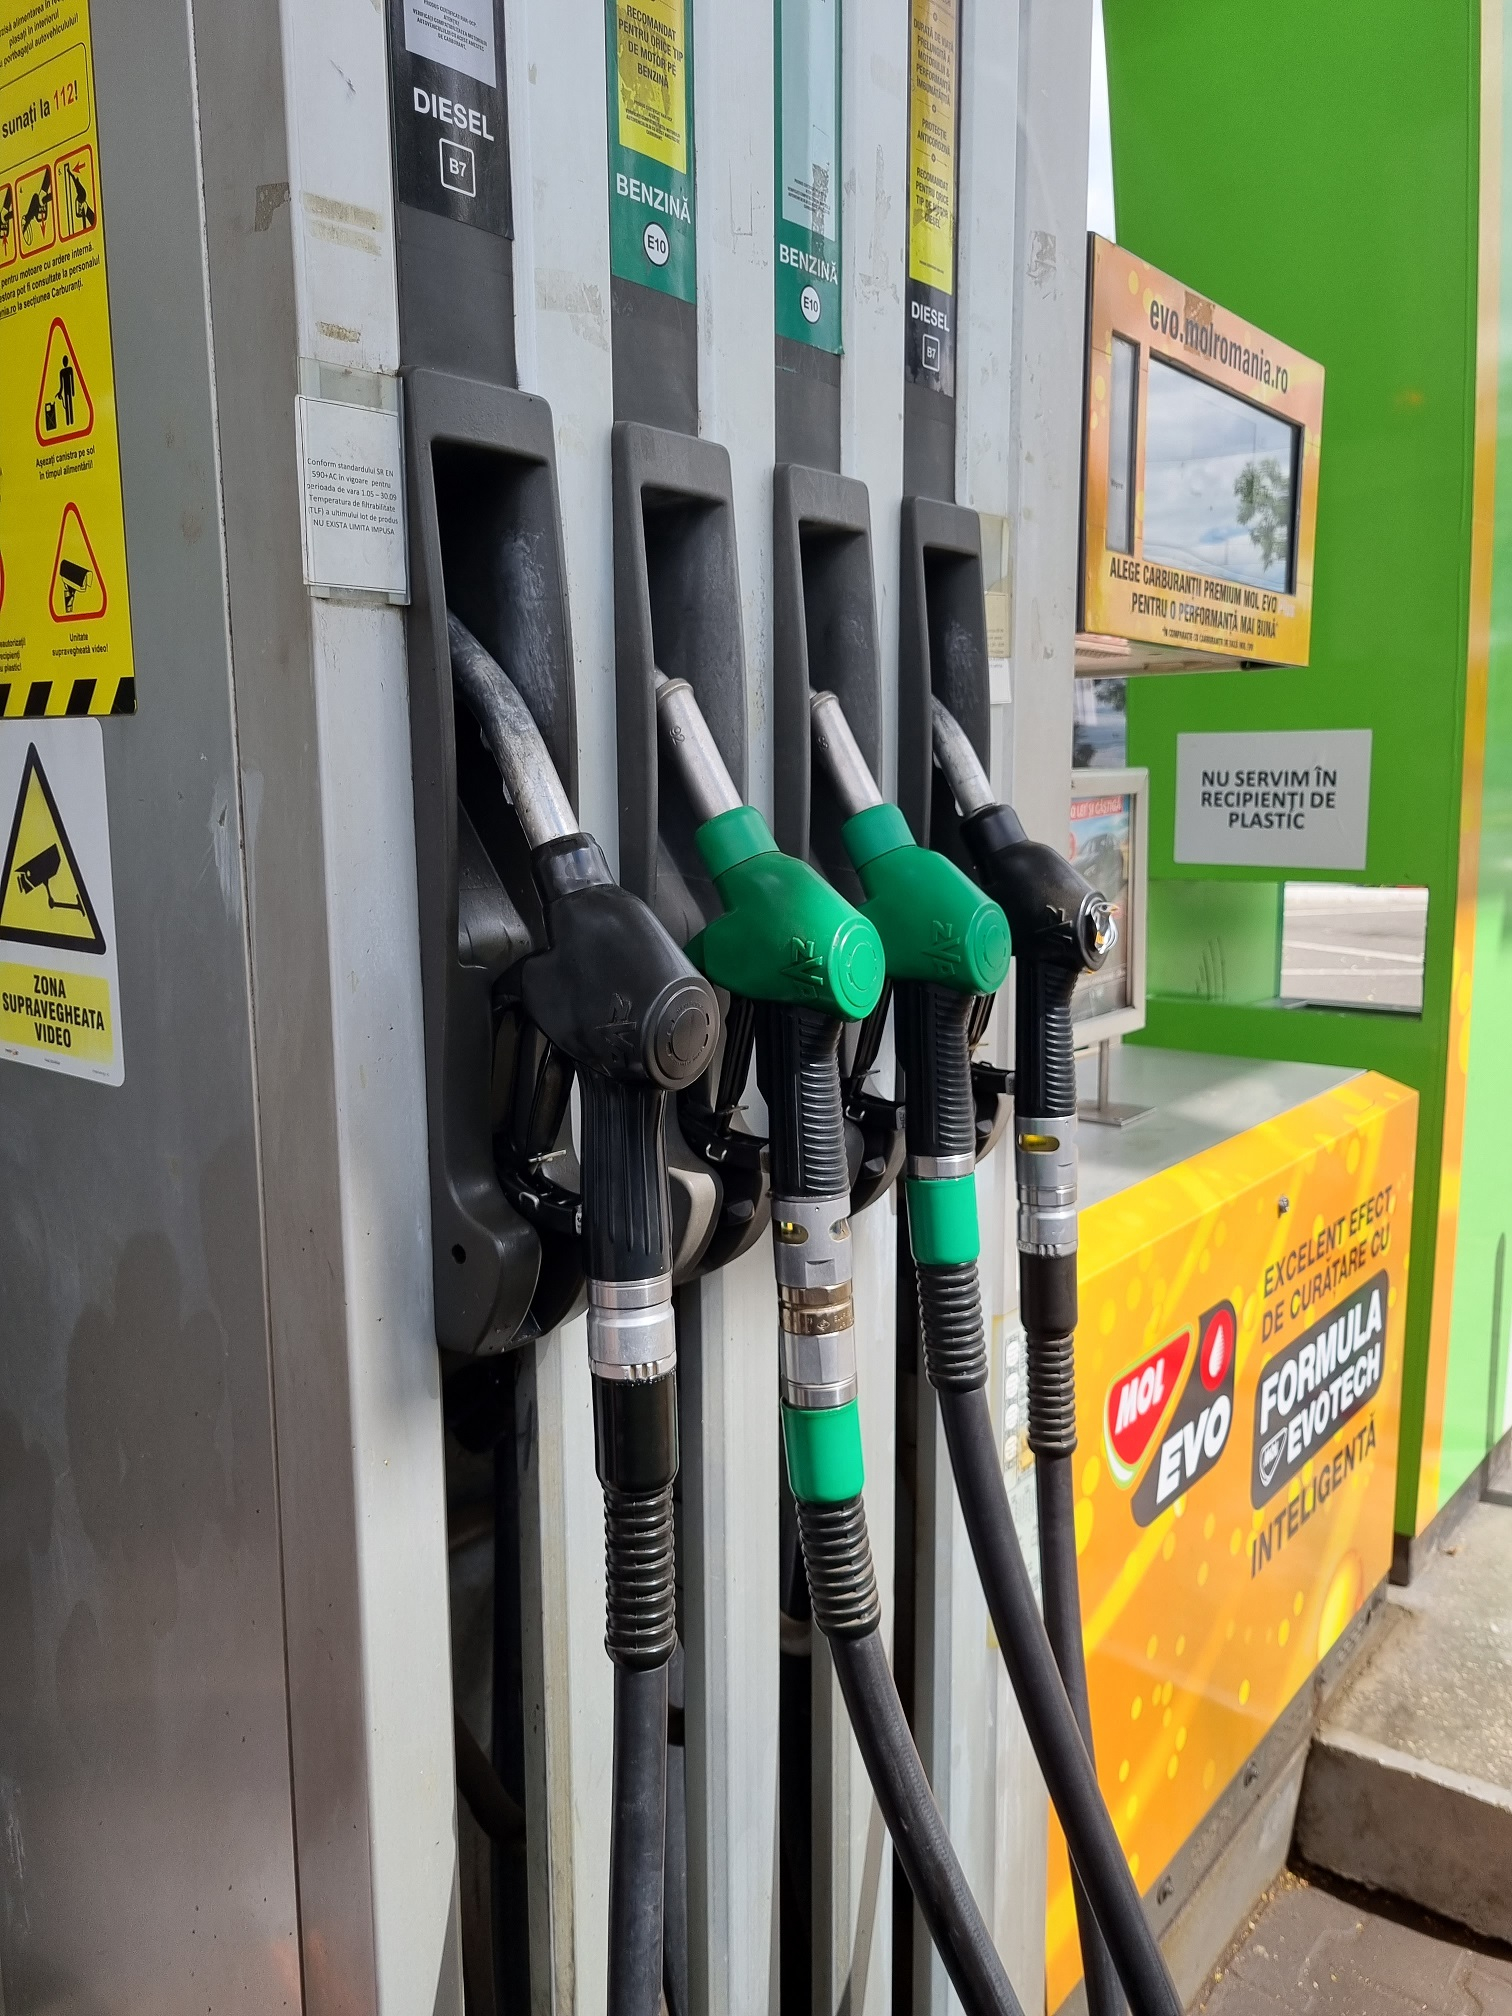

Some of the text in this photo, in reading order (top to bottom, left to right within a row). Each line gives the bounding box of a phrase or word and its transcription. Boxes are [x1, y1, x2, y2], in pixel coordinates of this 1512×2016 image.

[627, 5, 676, 41] RECOMANDAT
[619, 19, 683, 62] PENTRU ORICE TIP
[628, 41, 676, 76] DE MOTOR PE
[638, 63, 668, 88] BENZINĂ
[2, 80, 77, 138] sunați la 112!
[414, 87, 494, 142] DIESEL
[450, 158, 467, 177] B7
[917, 167, 948, 192] RECOMANDAT
[617, 173, 691, 224] BENZINĂ
[916, 181, 935, 198] PENTRU
[916, 195, 924, 205] TIP
[647, 235, 666, 254] E10
[1, 273, 18, 289] pentru
[20, 264, 42, 278] motoare
[44, 262, 51, 270] cu
[52, 253, 70, 266] ardere
[779, 244, 838, 285] BENZINĂ
[17, 285, 26, 298] pot
[27, 282, 31, 291] fi
[32, 272, 61, 290] consultate
[62, 269, 67, 278] la
[18, 302, 22, 311] la
[24, 292, 50, 308] secțiunea
[804, 296, 818, 312] E10
[911, 301, 950, 332] DIESEL
[927, 346, 936, 359] B7
[1150, 300, 1288, 394] evo.molromania.ro
[56, 451, 77, 463] canistra
[78, 449, 85, 458] pe
[87, 445, 95, 455] sol
[46, 467, 62, 479] timpul
[308, 457, 336, 468] Conform
[338, 462, 375, 474] standardului
[386, 469, 394, 478] EN
[307, 483, 336, 493] perioada
[338, 485, 345, 493] de
[347, 488, 360, 496] vara
[362, 488, 374, 498] 1.05
[346, 475, 368, 485] vigoare
[371, 479, 391, 488] pentru
[309, 494, 351, 506] Temperatura
[353, 499, 360, 507] de
[314, 519, 394, 535] NU EXISTA LIMITA IMPUSA
[332, 509, 358, 519] ultimului
[360, 512, 368, 520] lot
[370, 513, 377, 522] de
[378, 515, 398, 524] produs
[1110, 558, 1277, 613] ALEGE CARBURANȚII PREMIUM MOL EVO
[1132, 593, 1168, 619] PENTRU
[1170, 601, 1176, 619] O
[1178, 602, 1238, 634] PERFORMANȚĂ
[1240, 615, 1254, 633] MAI
[70, 633, 88, 642] Unitate
[1202, 766, 1337, 787] NU SERVIM ÎN
[1201, 792, 1335, 812] RECIPIENȚI DE
[1229, 812, 1305, 829] PLASTIC
[34, 975, 66, 998] ZONA
[2, 992, 104, 1030] SUPRAVEGHEATA
[34, 1022, 71, 1048] VIDEO
[1264, 1185, 1394, 1299] EXCELENT EFECT
[1262, 1222, 1391, 1344] DE CURĂȚARE CU
[1260, 1288, 1382, 1435] FORMULA
[1114, 1358, 1165, 1437] MOL
[1286, 1342, 1381, 1465] EVOTECH
[1156, 1395, 1231, 1504] EVO
[1251, 1411, 1376, 1580] INTELIGENTĂ
